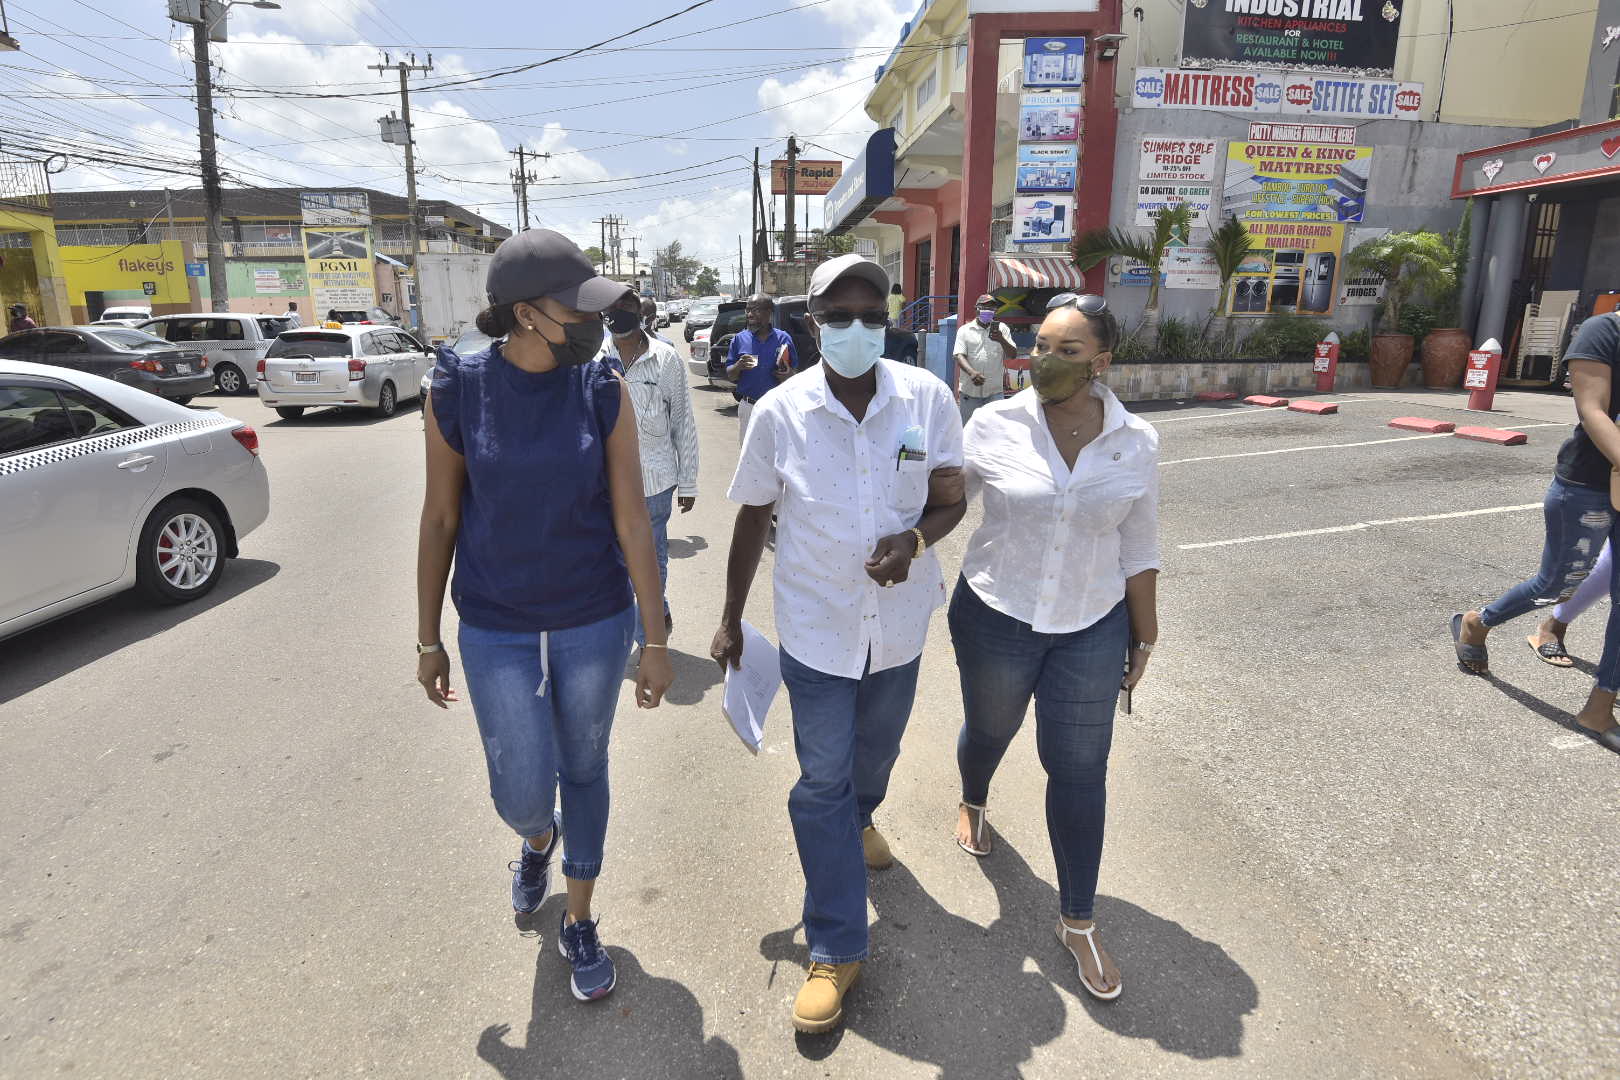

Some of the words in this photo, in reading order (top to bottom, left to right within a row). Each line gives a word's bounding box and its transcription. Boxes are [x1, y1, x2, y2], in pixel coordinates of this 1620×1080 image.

[1224, 0, 1363, 21] INDUSTRIAL
[1237, 16, 1281, 28] KITCHEN
[1284, 20, 1347, 32] APPLIANCES
[1236, 34, 1299, 47] RESTAURANT
[1301, 40, 1310, 48] &
[1312, 40, 1344, 50] HOTEL
[1243, 47, 1297, 59] AVAILABLE
[1138, 81, 1162, 94] SALE
[1164, 73, 1255, 107] MATTRESS
[1256, 85, 1281, 98] SALE
[1288, 88, 1312, 101] SALE
[1312, 80, 1364, 112] SETTEE
[1368, 84, 1398, 114] SET
[1396, 94, 1420, 107] SALE
[1250, 124, 1271, 140] PATTY
[1143, 141, 1186, 153] SUMMER
[1188, 142, 1214, 154] SALE
[1245, 145, 1298, 158] QUEEN
[1301, 147, 1312, 159] &
[1316, 148, 1355, 160] KING
[1155, 154, 1201, 164] FRIDGE
[801, 167, 834, 179] Rapid
[1259, 161, 1341, 175] MATTRESS
[1140, 186, 1149, 195] GO
[1151, 186, 1175, 195] DIGITAL
[1178, 187, 1187, 196] GO
[1189, 187, 1210, 196] GREEN
[1249, 223, 1264, 234] ALL
[1265, 224, 1296, 235] MAJOR
[1296, 225, 1333, 237] BRANDS
[1265, 237, 1310, 248] AVAILABLE
[118, 258, 175, 276] flakeys
[319, 261, 358, 272] PGMI
[1346, 287, 1377, 296] FRIDGES
